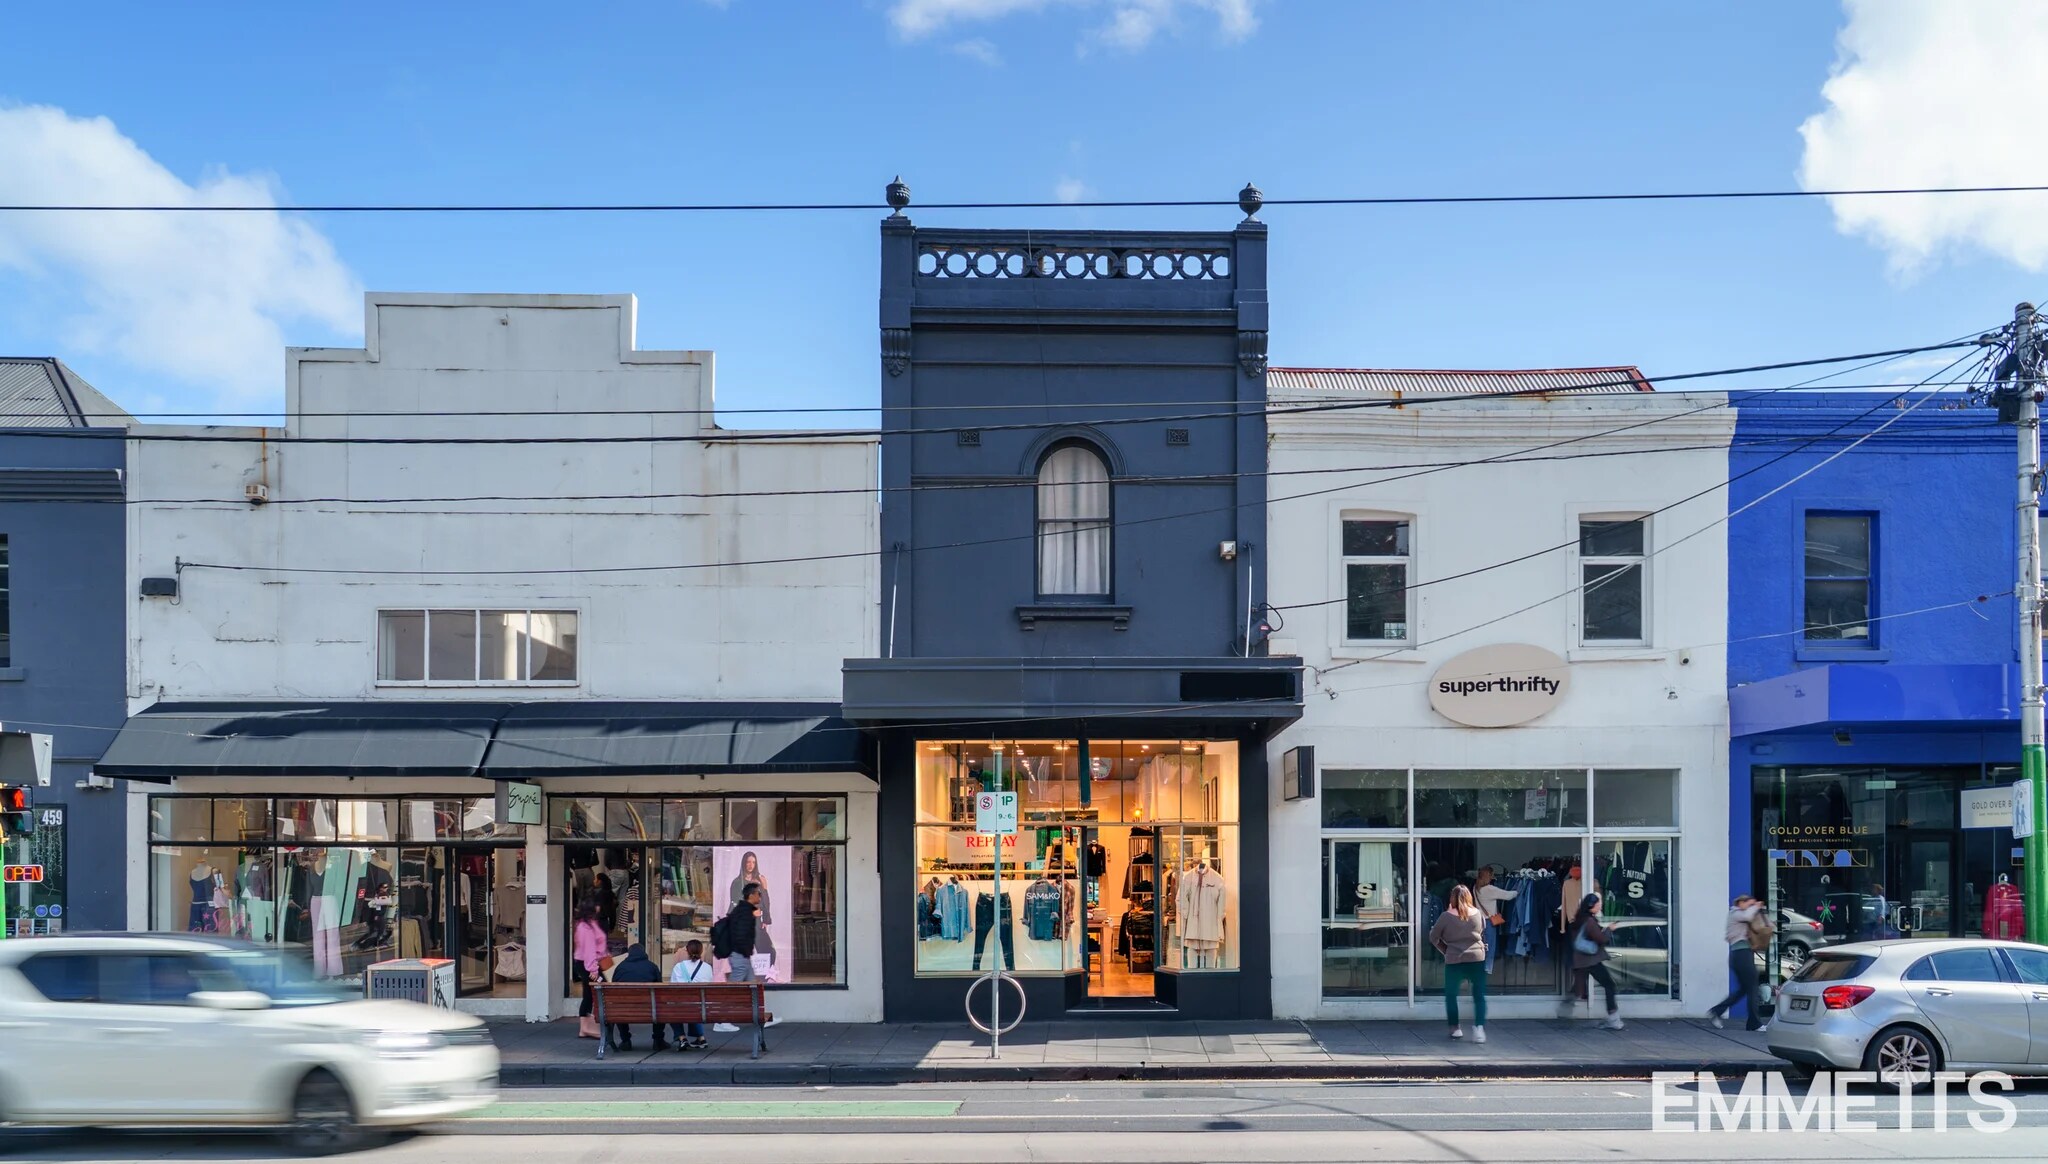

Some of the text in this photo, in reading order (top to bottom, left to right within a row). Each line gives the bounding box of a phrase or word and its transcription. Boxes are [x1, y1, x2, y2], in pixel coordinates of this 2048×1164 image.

[1439, 676, 1560, 696] superthrifty
[1001, 796, 1013, 806] 1P
[1971, 801, 1988, 810] GOLD
[1989, 800, 2006, 809] OVER
[42, 809, 62, 825] 459
[1769, 826, 1868, 835] GOLD OVER BLUE
[4, 866, 42, 881] OPEN
[1026, 892, 1061, 900] SAM&KO
[1628, 881, 1644, 899] S
